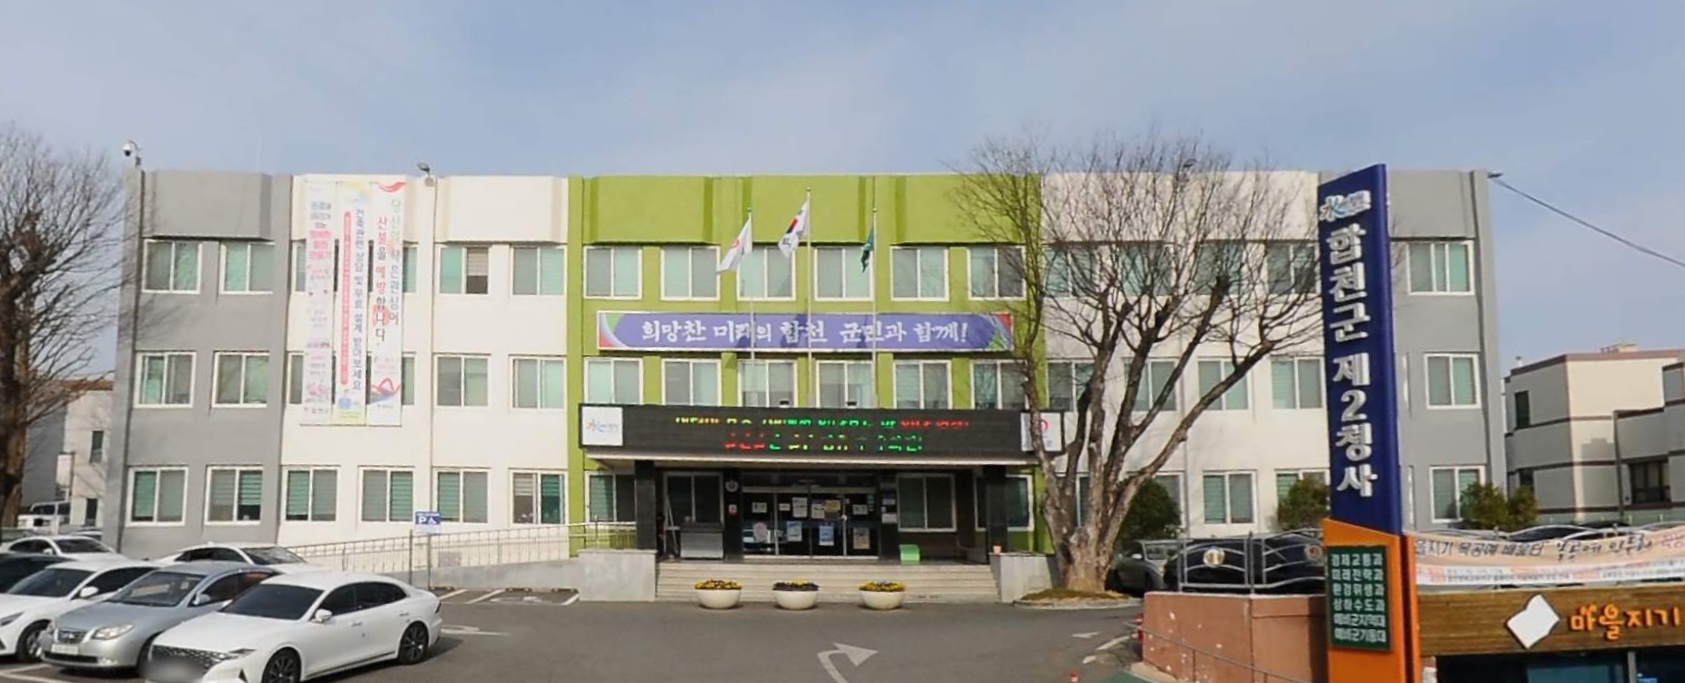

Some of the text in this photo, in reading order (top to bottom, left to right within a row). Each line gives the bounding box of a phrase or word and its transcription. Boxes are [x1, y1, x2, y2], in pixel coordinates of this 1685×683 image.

[377, 216, 387, 261] 산불을
[1326, 222, 1372, 343] 합천군
[641, 320, 969, 343] 희망찬 미래의 합천 군민과 함께!
[352, 337, 362, 390] 받아보세요
[1332, 352, 1379, 497] 제2청사
[418, 516, 427, 524] P
[1457, 541, 1498, 557] 목공예
[1502, 542, 1545, 557] 배움터
[1333, 597, 1385, 611] 상하수도과
[1569, 603, 1681, 641] 마을지기
